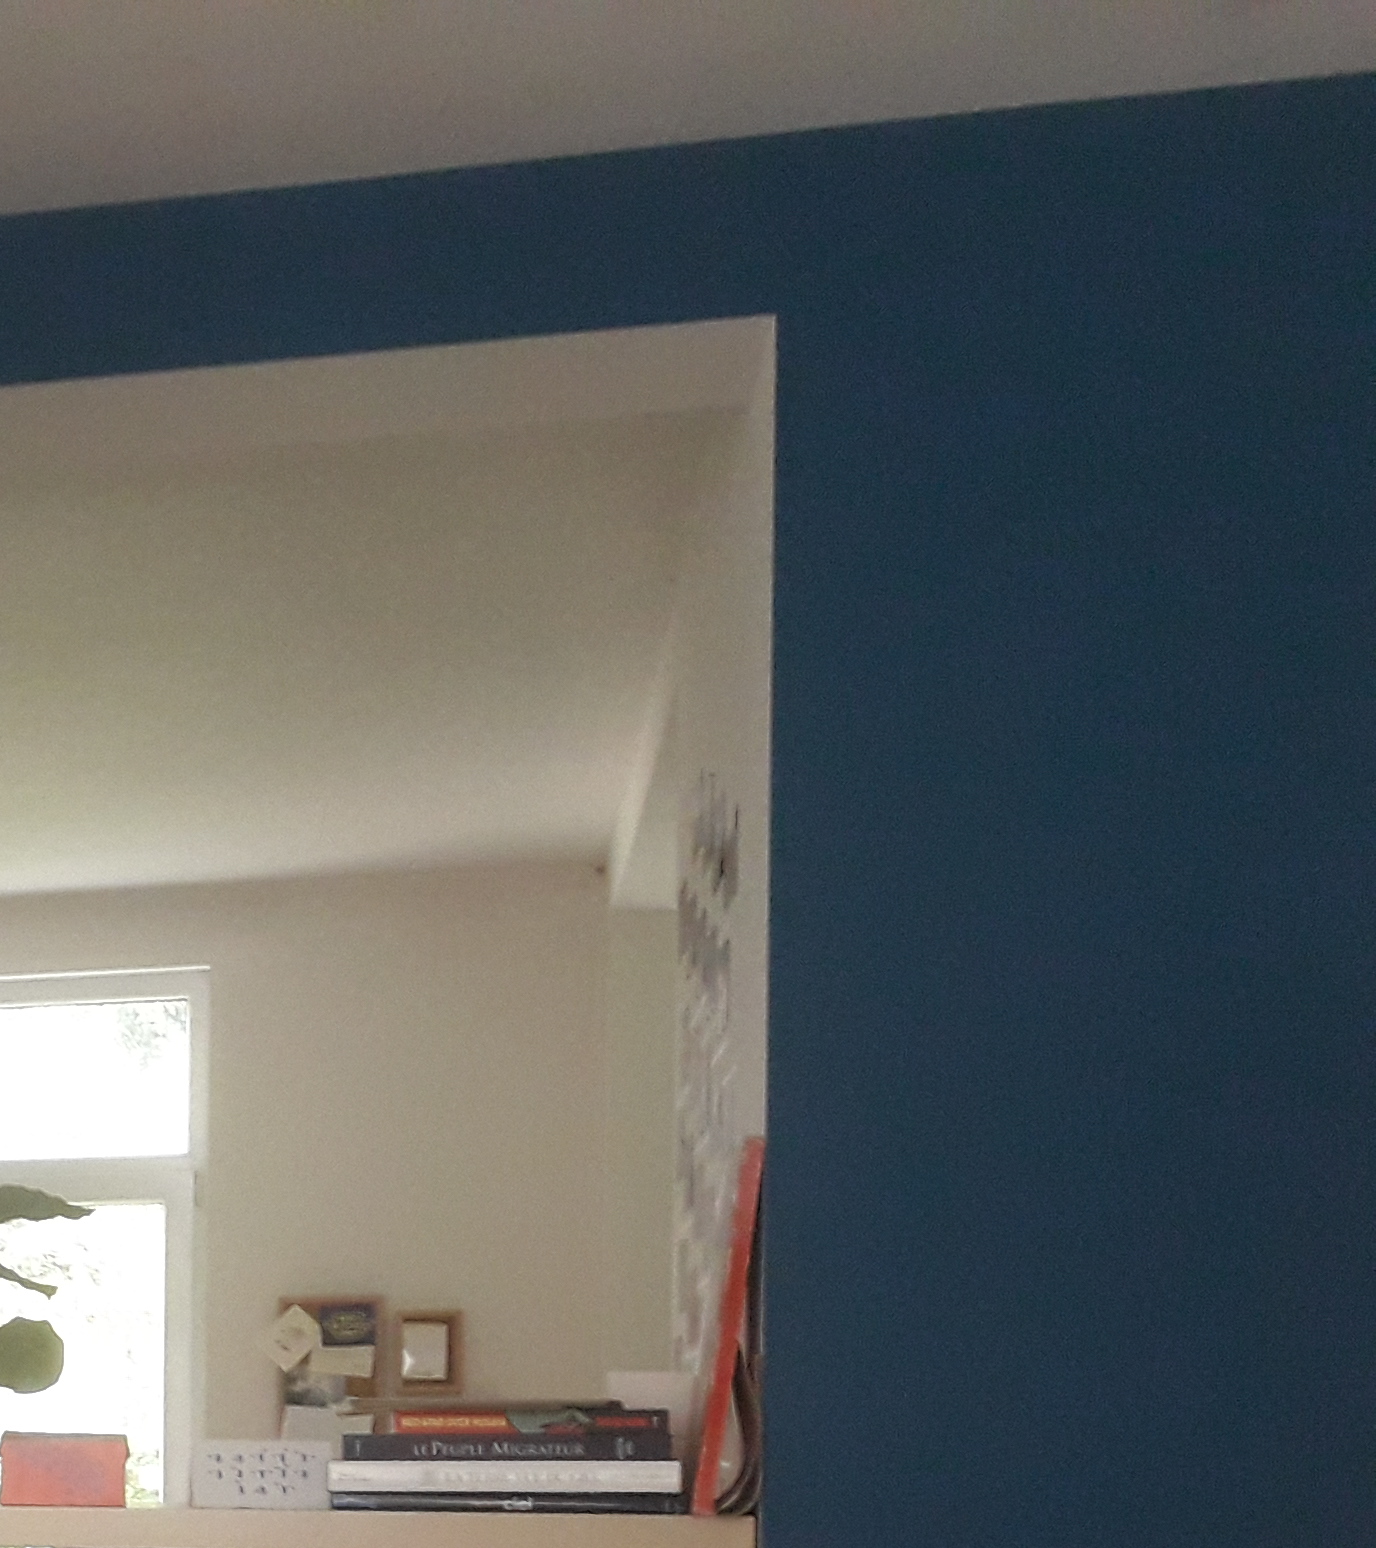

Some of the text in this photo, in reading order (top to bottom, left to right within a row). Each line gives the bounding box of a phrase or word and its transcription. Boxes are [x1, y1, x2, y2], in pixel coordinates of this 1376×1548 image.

[413, 1440, 586, 1457] LE PEUPLE MIGRATEUR
